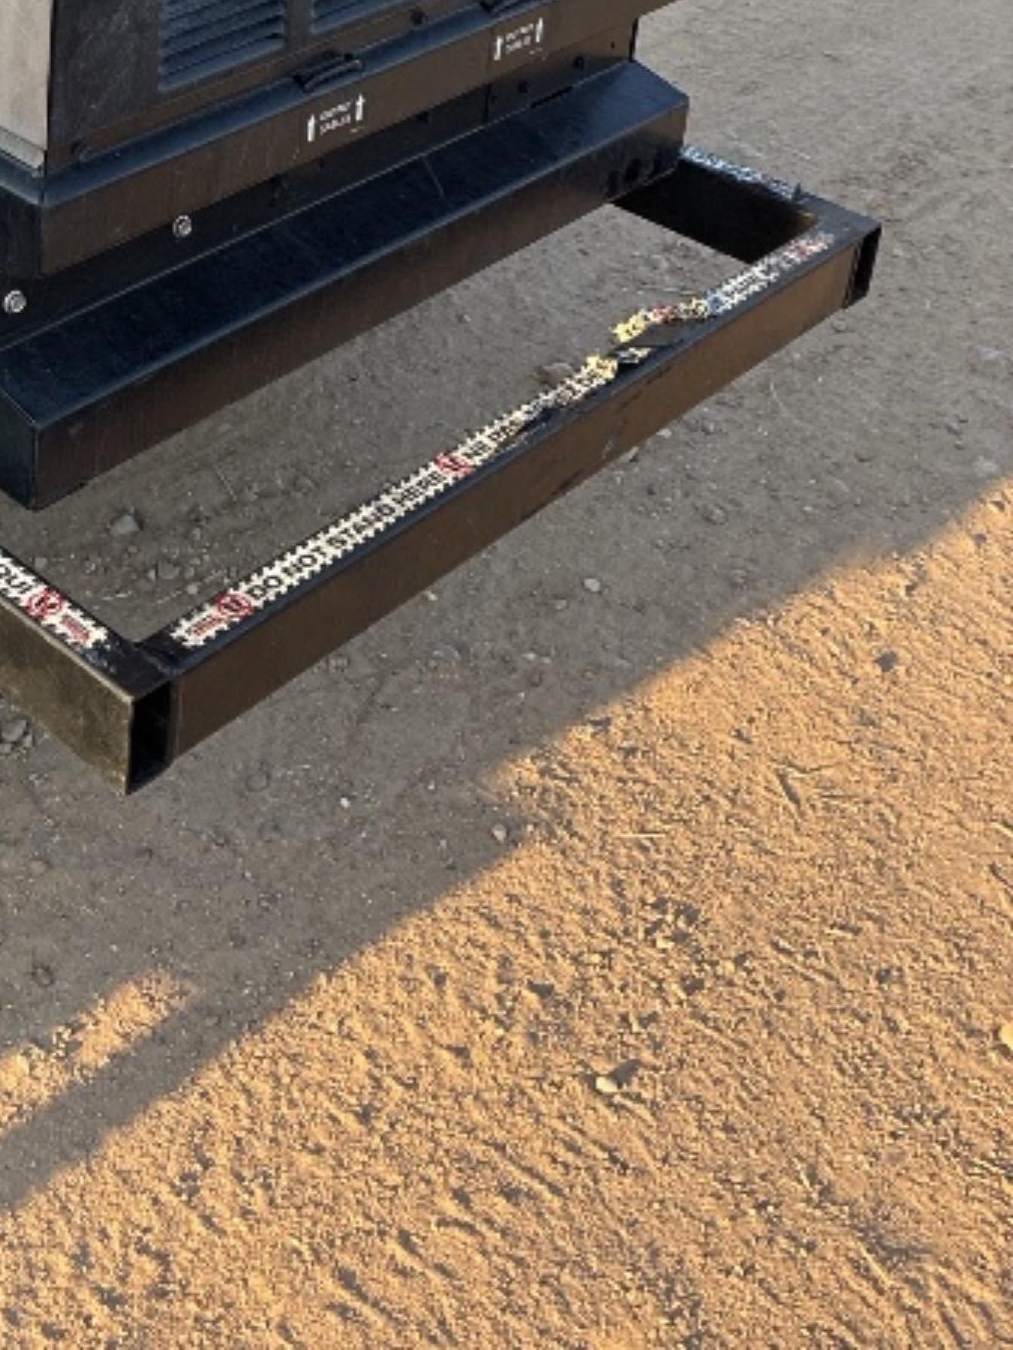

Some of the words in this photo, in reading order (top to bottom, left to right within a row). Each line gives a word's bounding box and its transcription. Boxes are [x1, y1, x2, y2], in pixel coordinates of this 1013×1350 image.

[246, 574, 284, 599] DO
[281, 545, 328, 578] NOT
[326, 502, 396, 549] STAND
